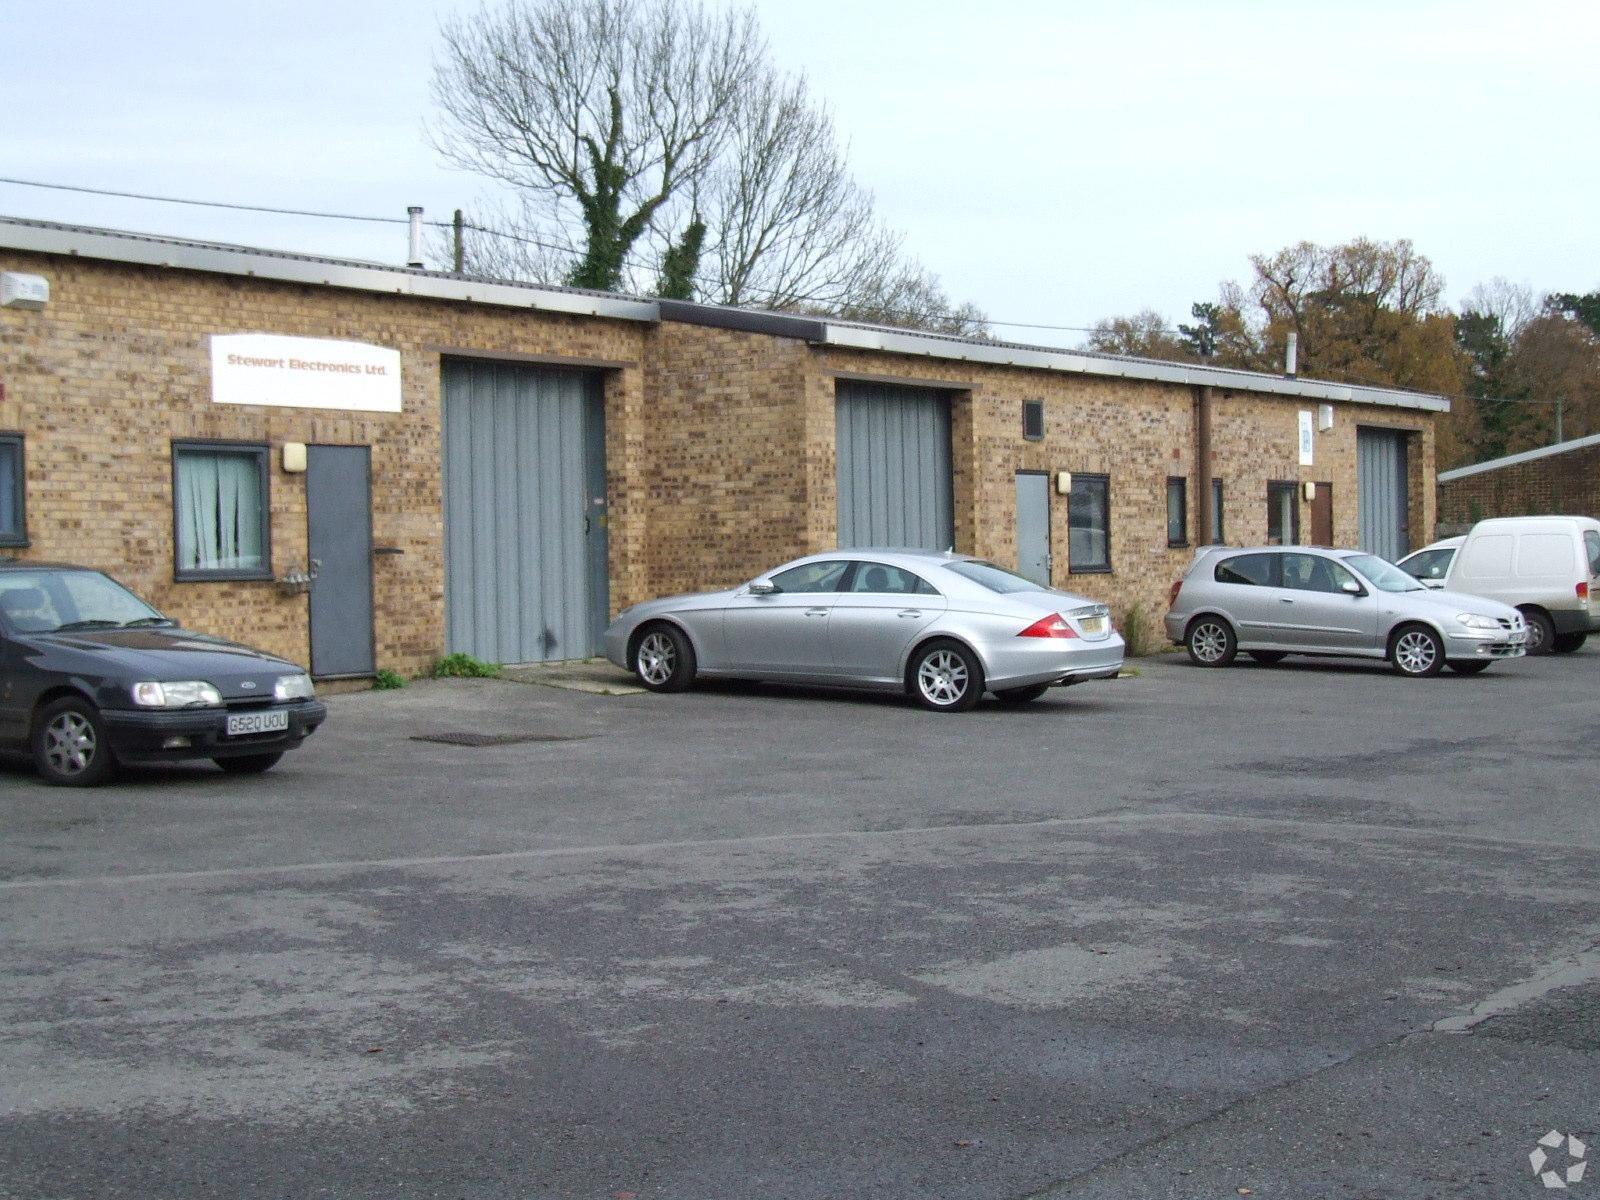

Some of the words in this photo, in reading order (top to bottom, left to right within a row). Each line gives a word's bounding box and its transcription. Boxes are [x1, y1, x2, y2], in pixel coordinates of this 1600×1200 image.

[227, 353, 285, 368] Stewart
[289, 358, 361, 375] Electronics
[365, 364, 388, 376] Ltd.
[230, 714, 262, 732] G520
